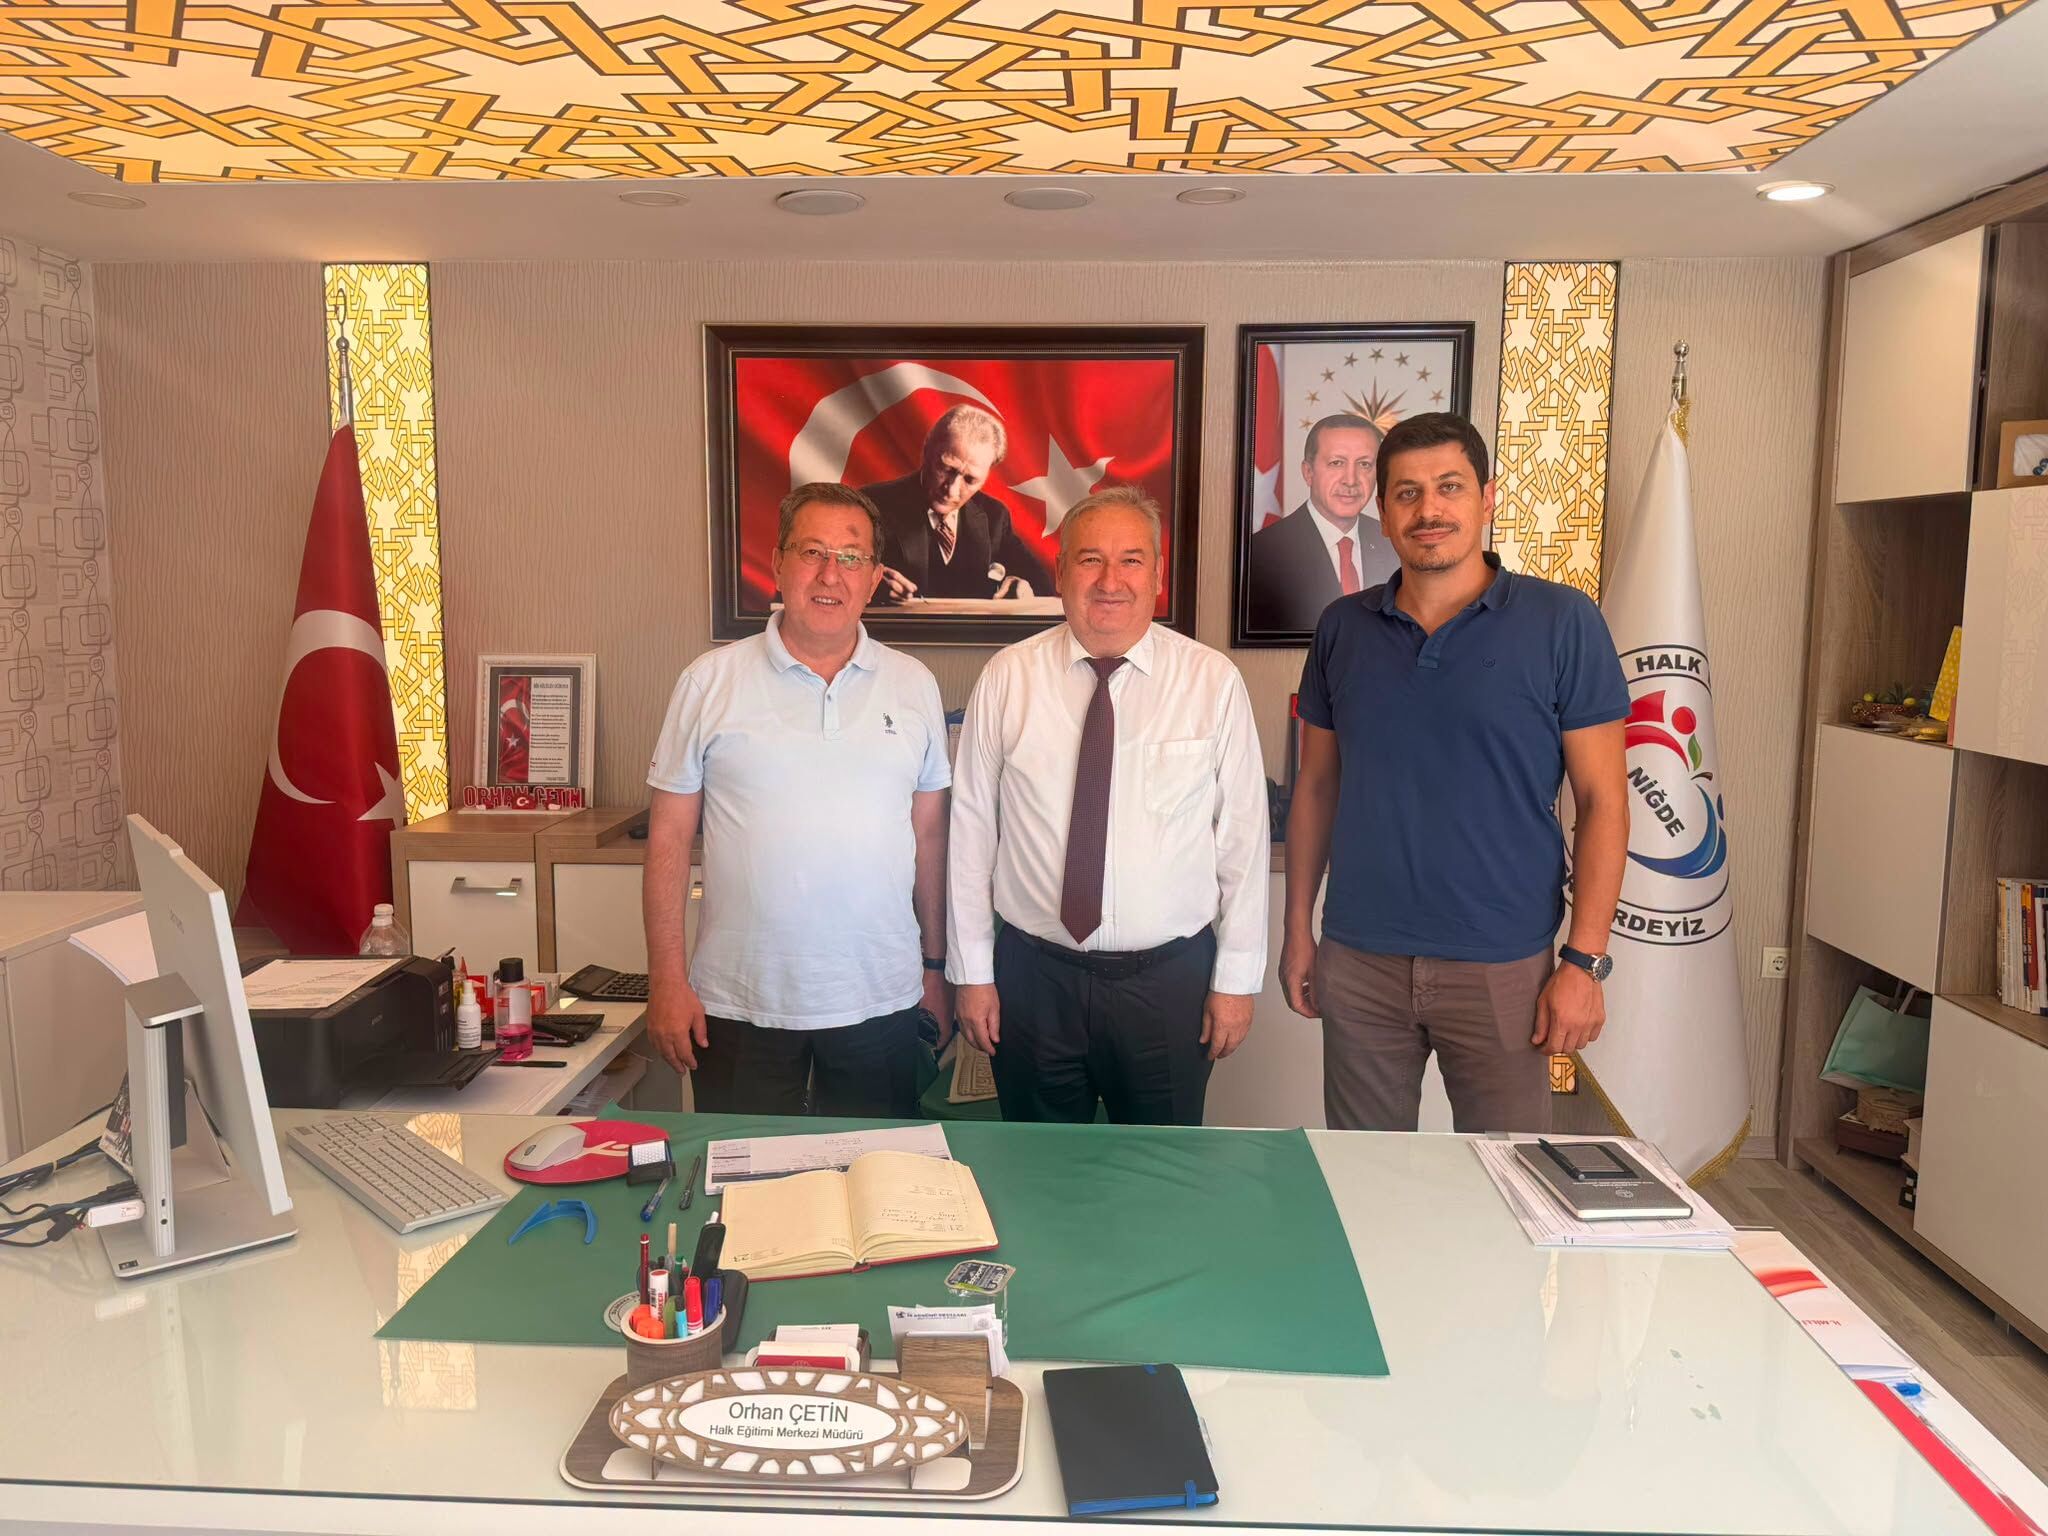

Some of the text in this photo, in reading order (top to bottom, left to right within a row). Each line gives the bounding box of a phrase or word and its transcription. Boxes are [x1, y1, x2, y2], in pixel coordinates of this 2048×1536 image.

[1635, 653, 1702, 675] HALK
[1627, 766, 1686, 838] NİĞDE
[1612, 907, 1706, 937] RDEYİZ
[729, 1401, 848, 1425] Orhan ÇETİN
[709, 1425, 864, 1440] Halk Eğitimi Merkezi Müdürü
